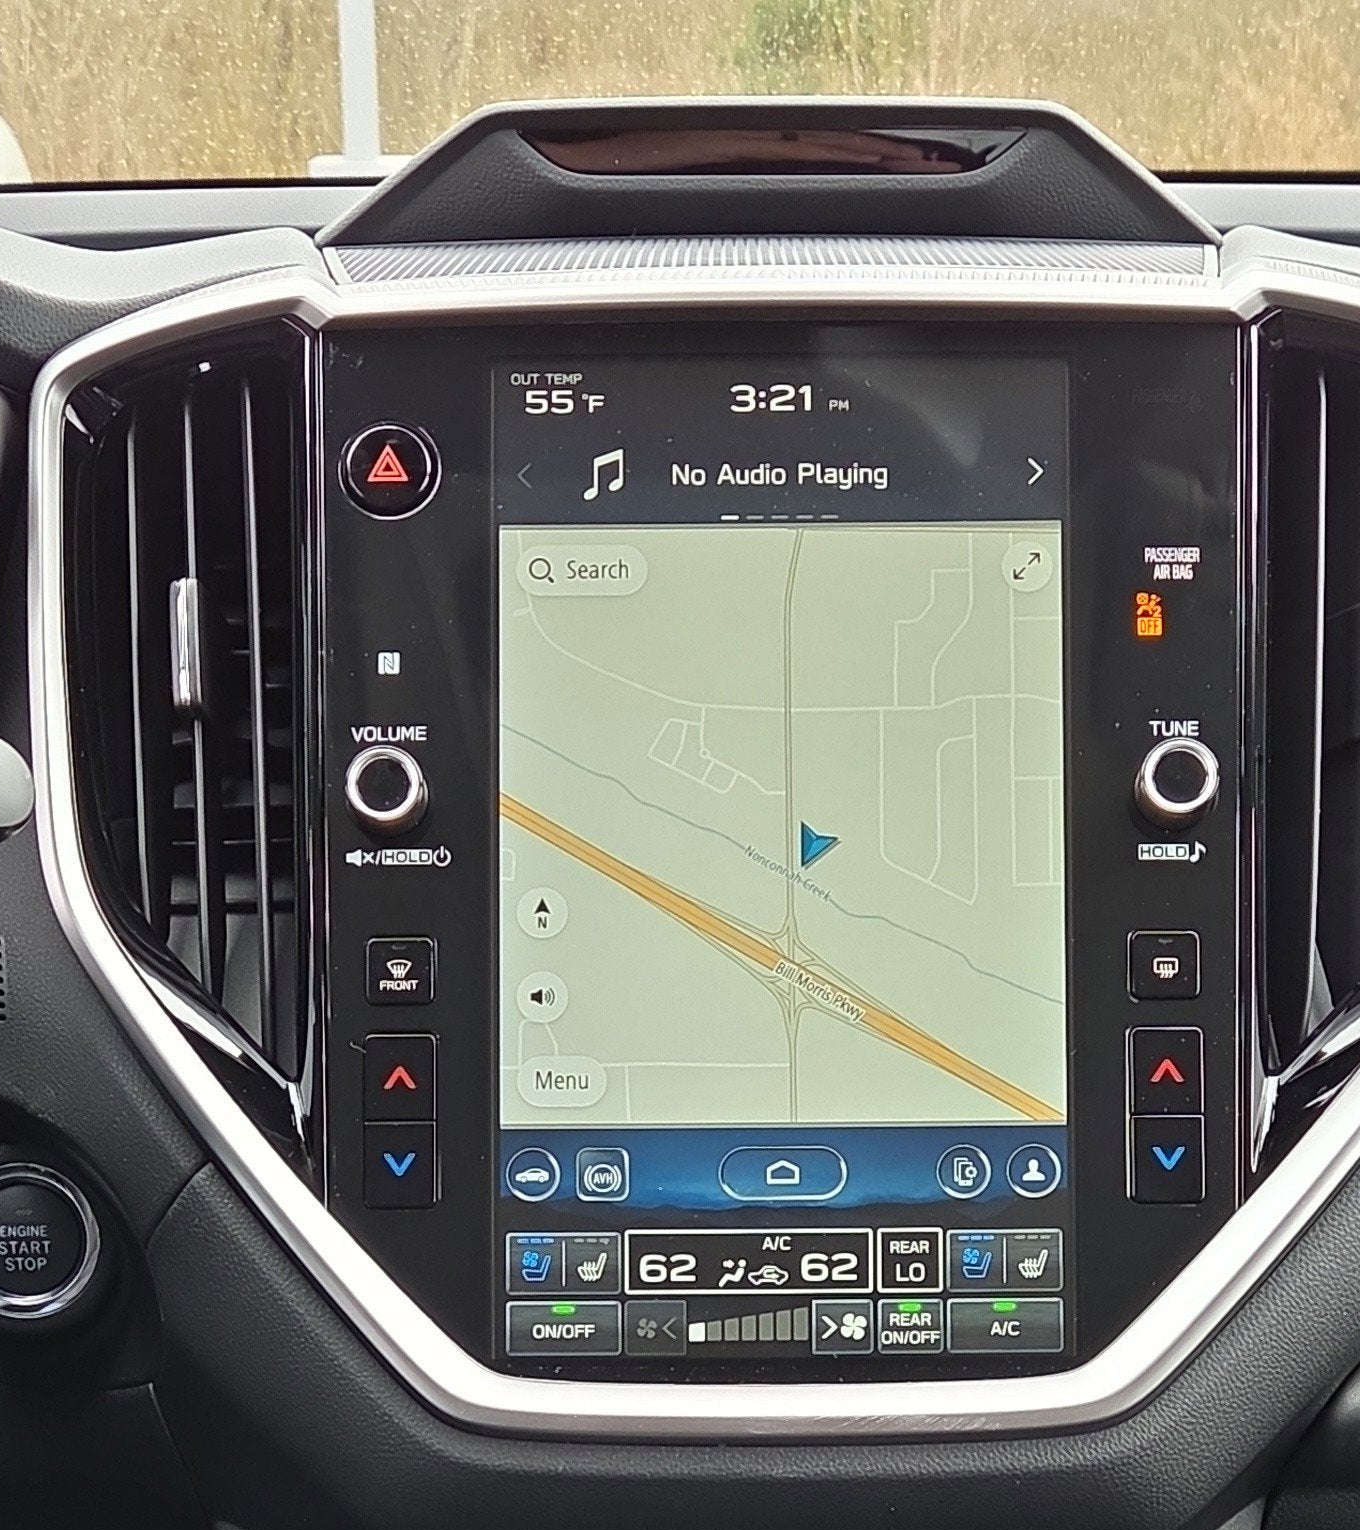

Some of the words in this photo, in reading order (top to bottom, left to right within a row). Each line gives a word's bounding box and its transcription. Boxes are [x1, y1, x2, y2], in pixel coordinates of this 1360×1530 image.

[510, 373, 539, 385] OUT
[545, 373, 583, 385] TEMP
[525, 390, 575, 414] 55
[729, 384, 813, 412] 3:21
[829, 399, 849, 412] PM
[672, 465, 706, 487] No
[717, 463, 787, 487] Audio
[798, 463, 889, 490] Playing
[1144, 547, 1200, 563] PASSENGER
[566, 559, 629, 580] Search
[1153, 564, 1171, 580] AIR
[1173, 565, 1193, 580] BAG
[1139, 619, 1161, 634] OFF
[351, 726, 427, 742] VOLUME
[1149, 720, 1200, 736] TUNE
[383, 850, 432, 864] HOLD
[1139, 845, 1189, 859] HOLD
[537, 917, 548, 929] N
[379, 979, 419, 991] FRONT
[774, 961, 797, 983] Bill
[797, 972, 834, 1004] Morris
[534, 1071, 589, 1090] Menu
[593, 1172, 614, 1185] AVH
[761, 1236, 792, 1251] A/C
[890, 1240, 929, 1254] REAR
[4, 1257, 48, 1272] STOP
[638, 1254, 697, 1283] 62
[800, 1252, 859, 1281] 62
[895, 1263, 925, 1282] LO
[889, 1312, 932, 1327] REAR
[532, 1322, 595, 1339] ON/OFF
[880, 1329, 941, 1345] ON/OFF
[990, 1321, 1021, 1337] A/C
